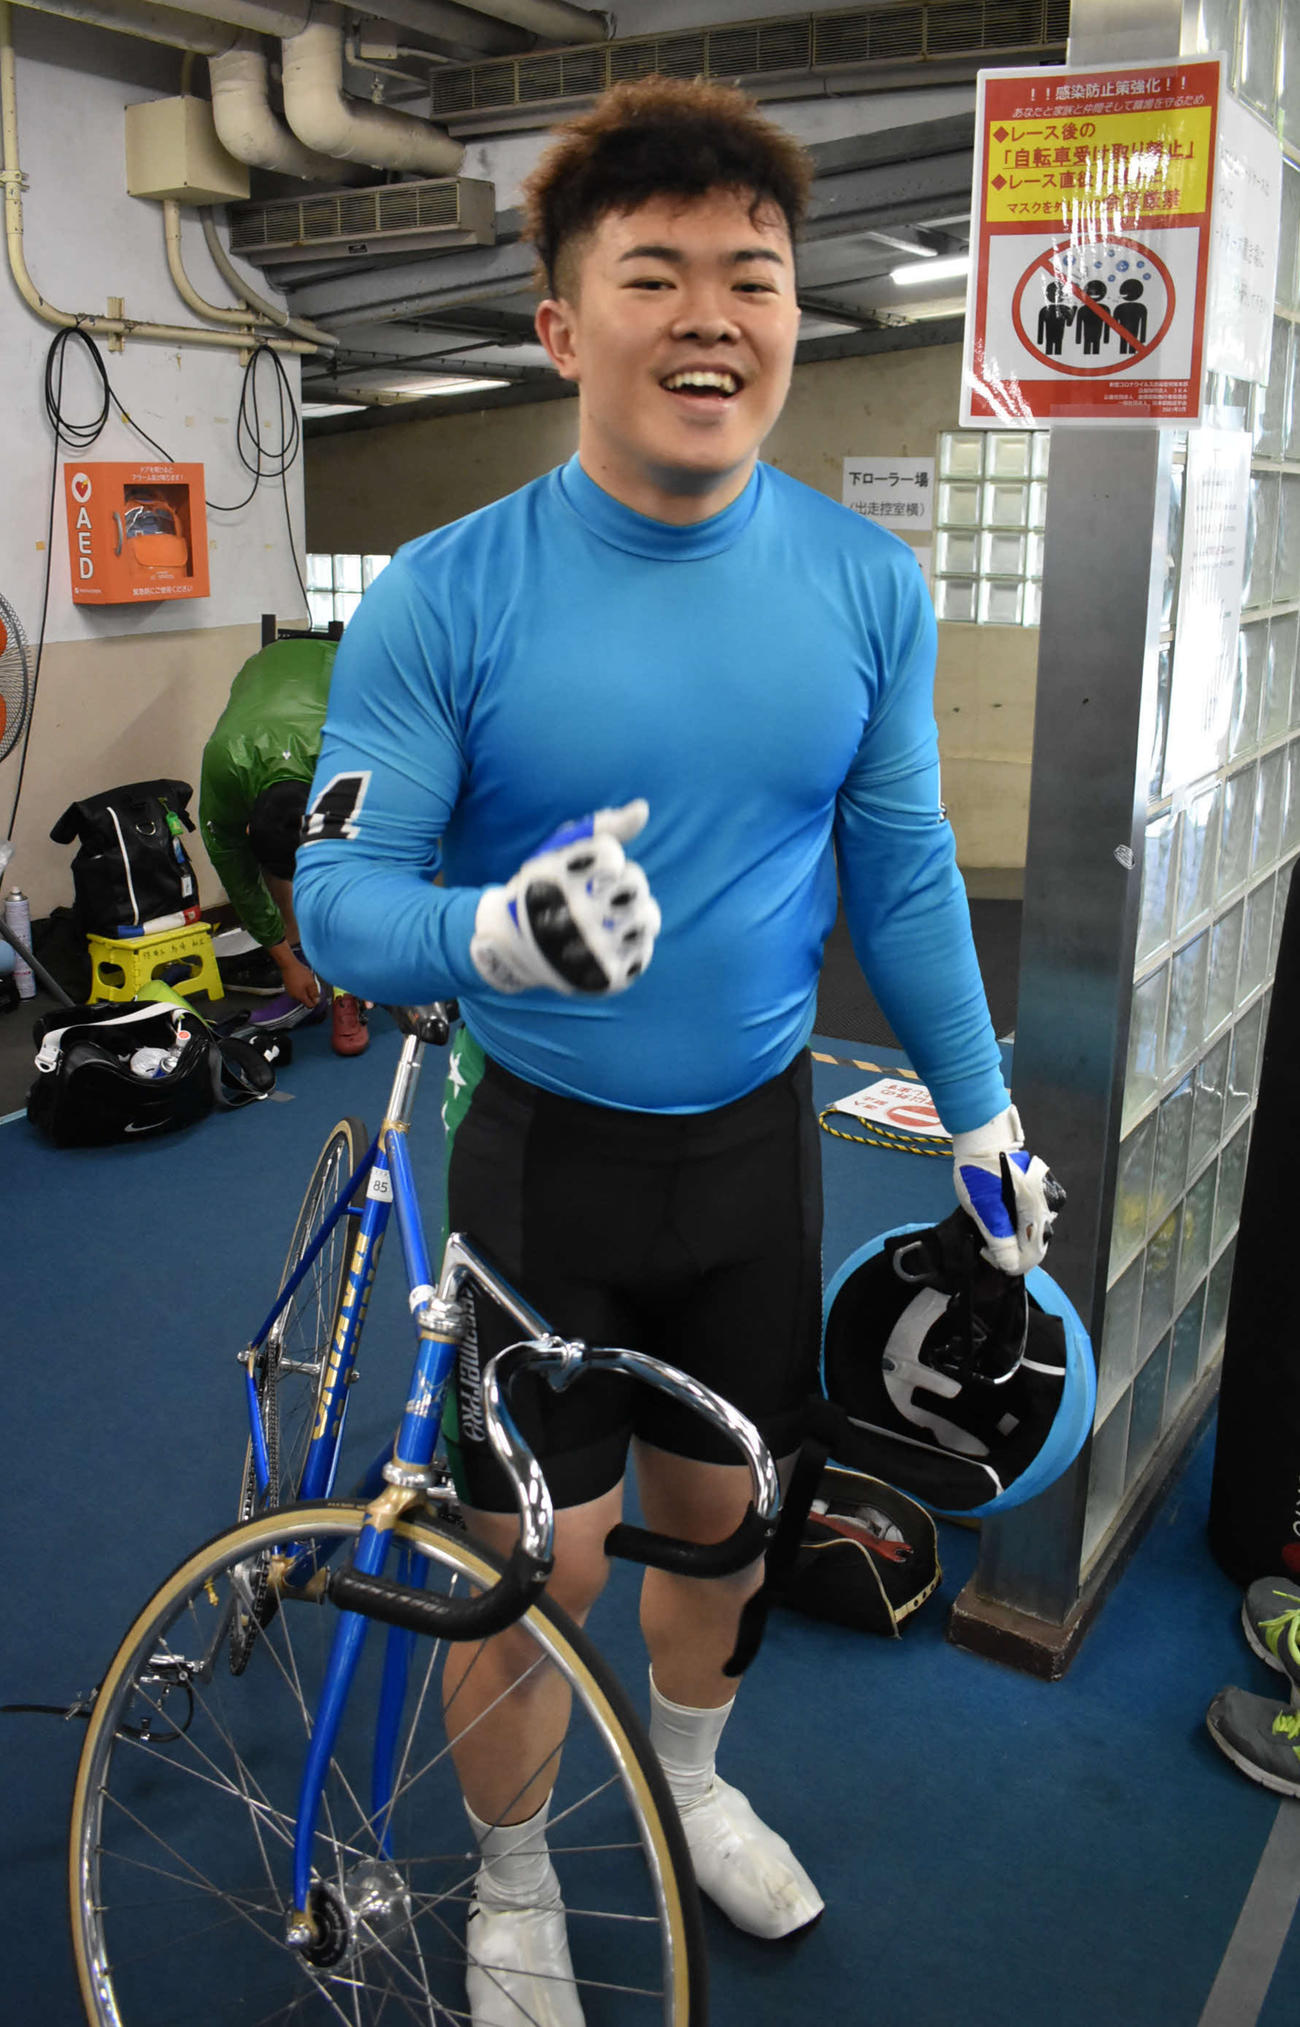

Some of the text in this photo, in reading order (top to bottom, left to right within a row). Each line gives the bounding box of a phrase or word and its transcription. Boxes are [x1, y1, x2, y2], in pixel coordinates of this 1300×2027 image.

[849, 472, 928, 487] 下ローラー場
[76, 506, 94, 580] AED
[373, 1180, 389, 1193] 85
